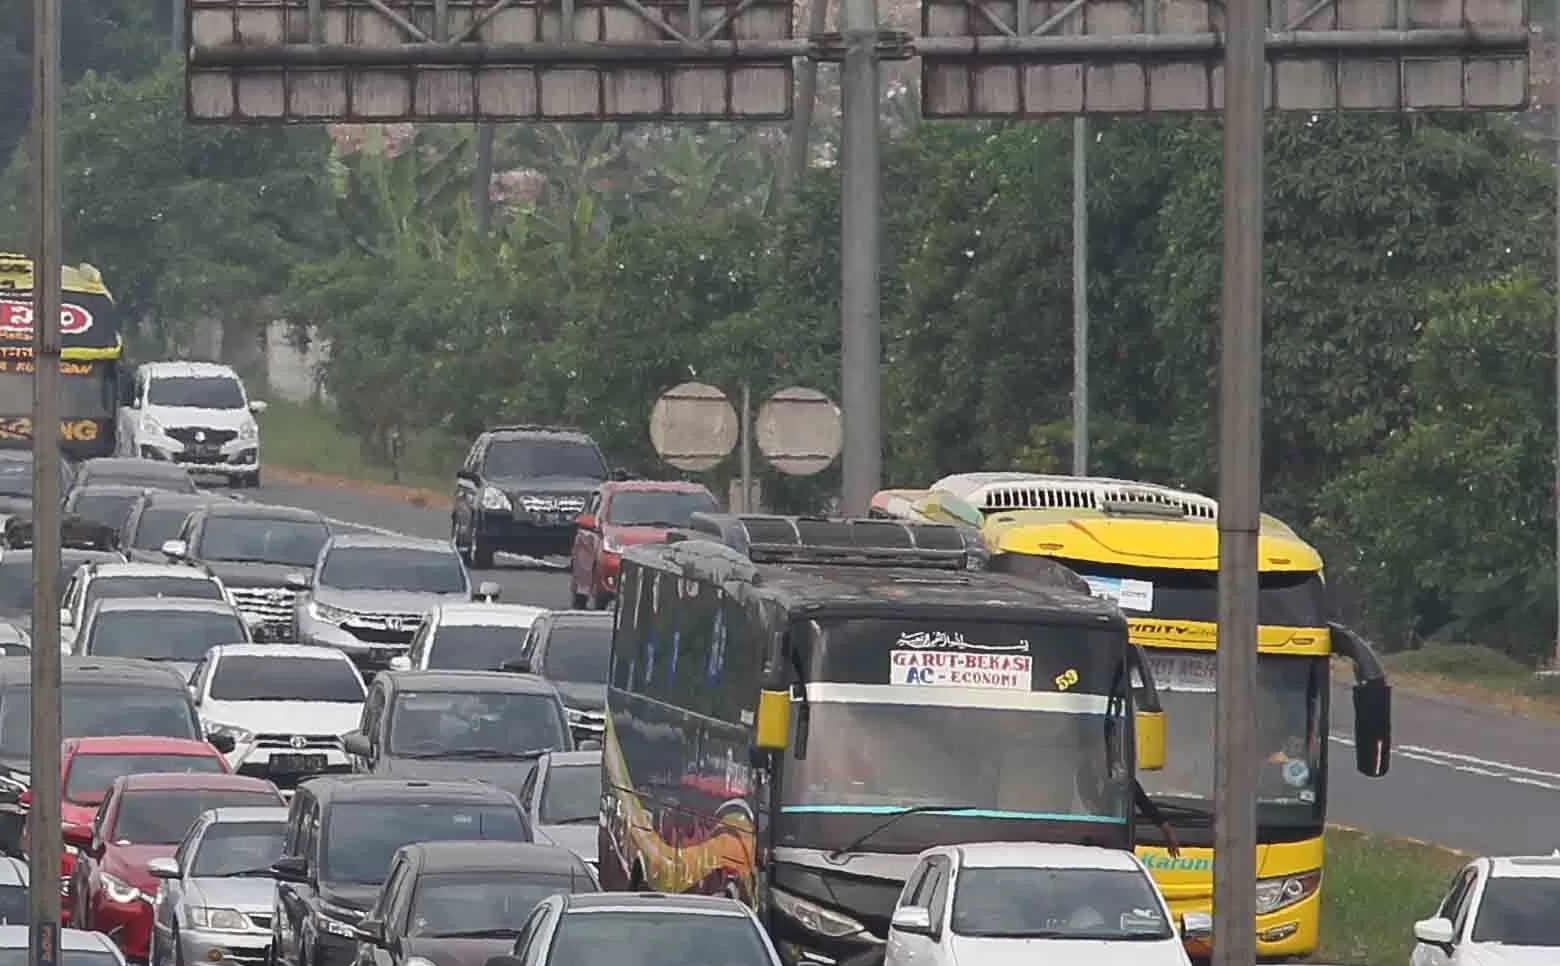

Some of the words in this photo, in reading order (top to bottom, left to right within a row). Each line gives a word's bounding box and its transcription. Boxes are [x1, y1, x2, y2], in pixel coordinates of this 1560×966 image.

[15, 360, 93, 375] KUGAN
[893, 653, 1031, 672] GARUT-BEKASI
[906, 666, 934, 684] AC
[950, 671, 1018, 686] ECONOMI
[1054, 669, 1081, 691] 59
